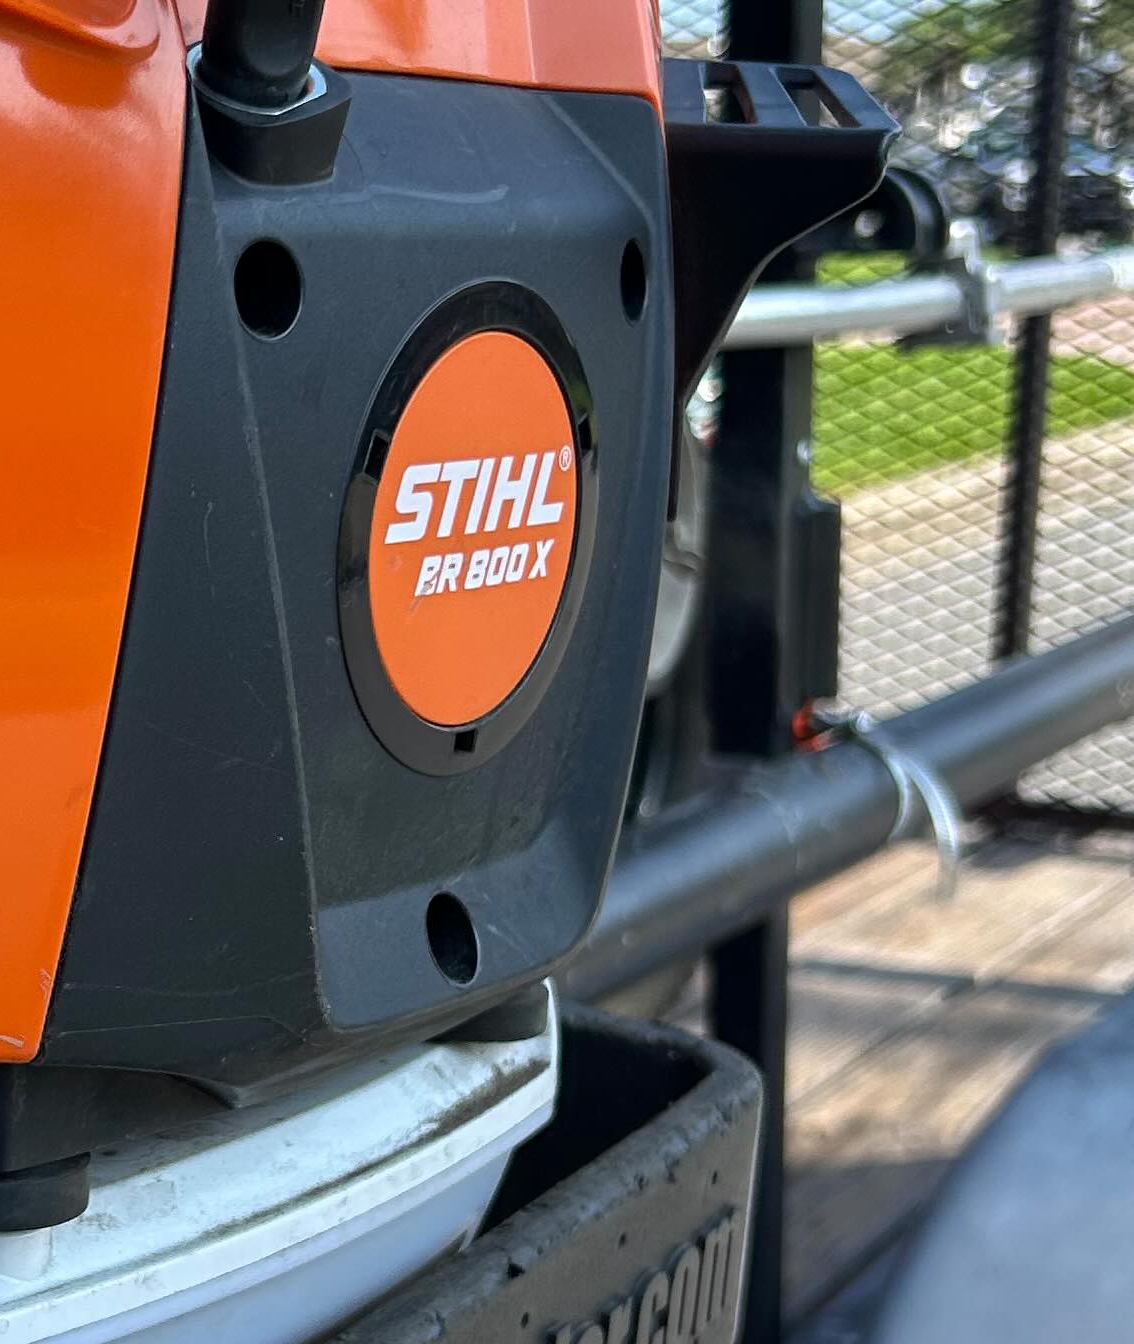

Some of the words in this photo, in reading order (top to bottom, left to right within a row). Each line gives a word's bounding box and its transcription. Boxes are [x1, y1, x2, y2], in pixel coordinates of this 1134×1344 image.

[413, 553, 463, 597] BR
[463, 546, 530, 591] 800
[530, 538, 555, 580] X
